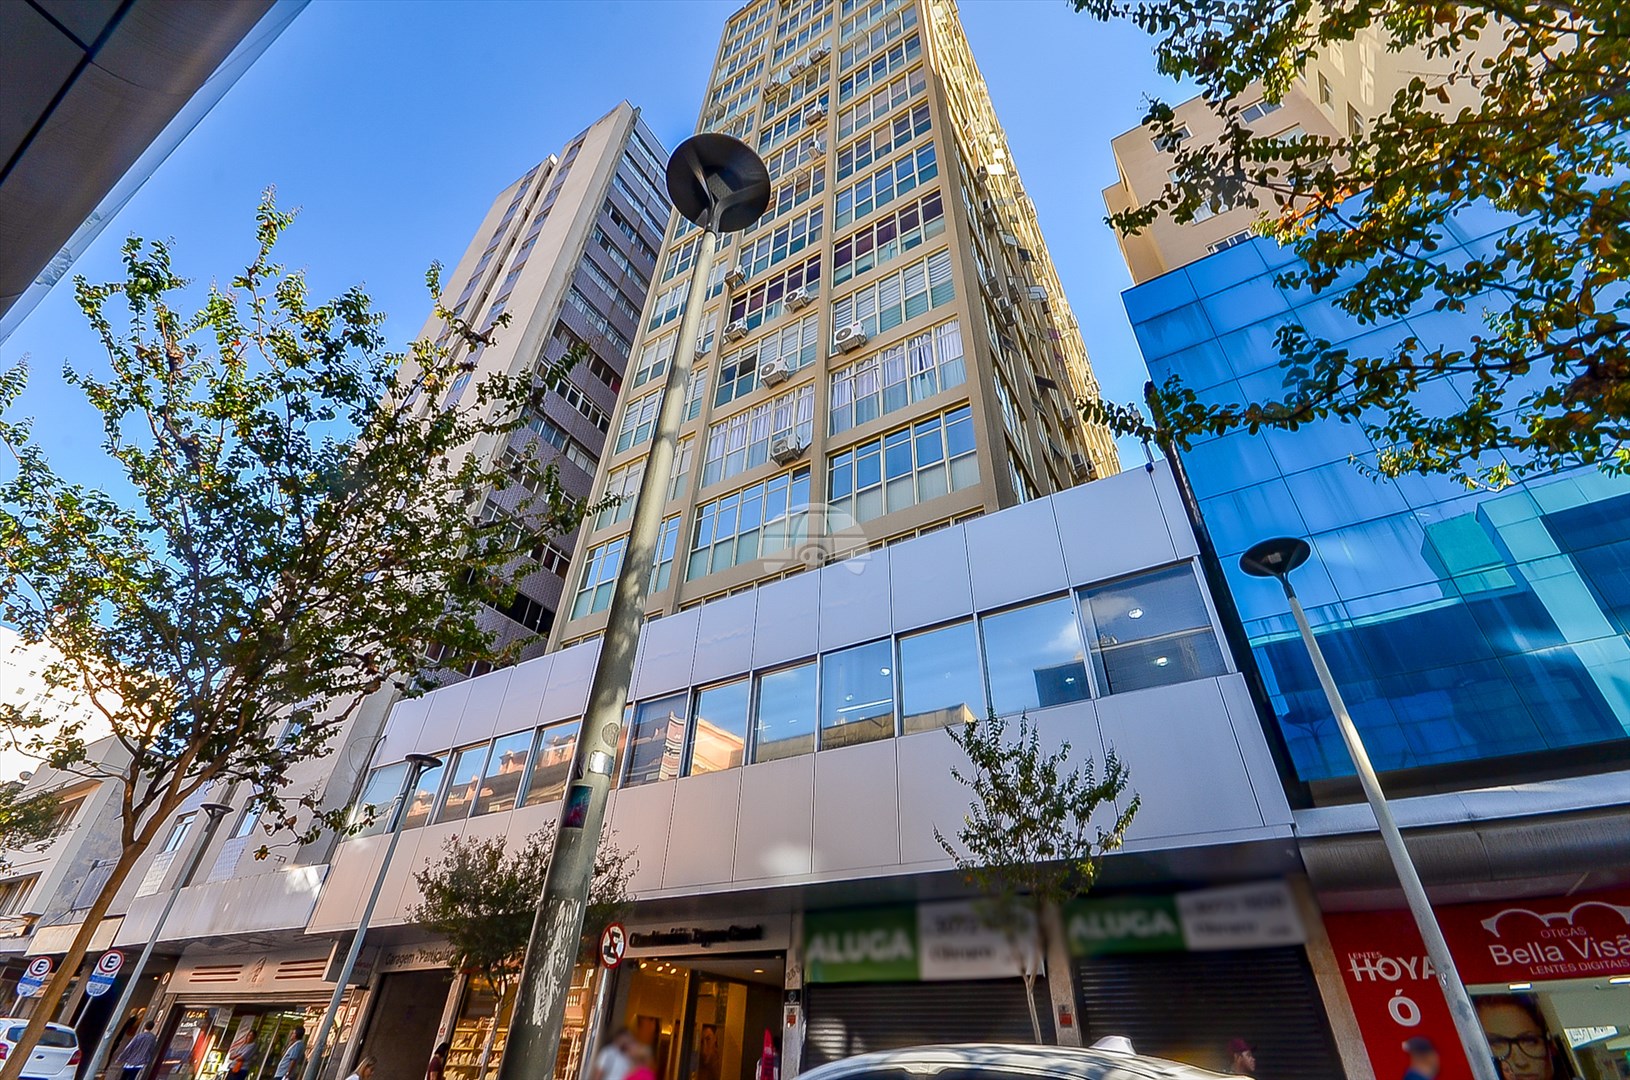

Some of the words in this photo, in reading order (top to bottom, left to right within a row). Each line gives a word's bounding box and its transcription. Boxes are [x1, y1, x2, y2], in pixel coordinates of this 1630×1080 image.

[1070, 909, 1177, 939] ALUGA
[806, 929, 913, 962] ALUGA
[1488, 941, 1565, 966] Bella
[35, 960, 47, 973] E
[105, 955, 117, 969] E
[1347, 956, 1436, 982] HOYA
[1529, 962, 1577, 975] LENTES
[1578, 958, 1630, 972] DIGITAIS
